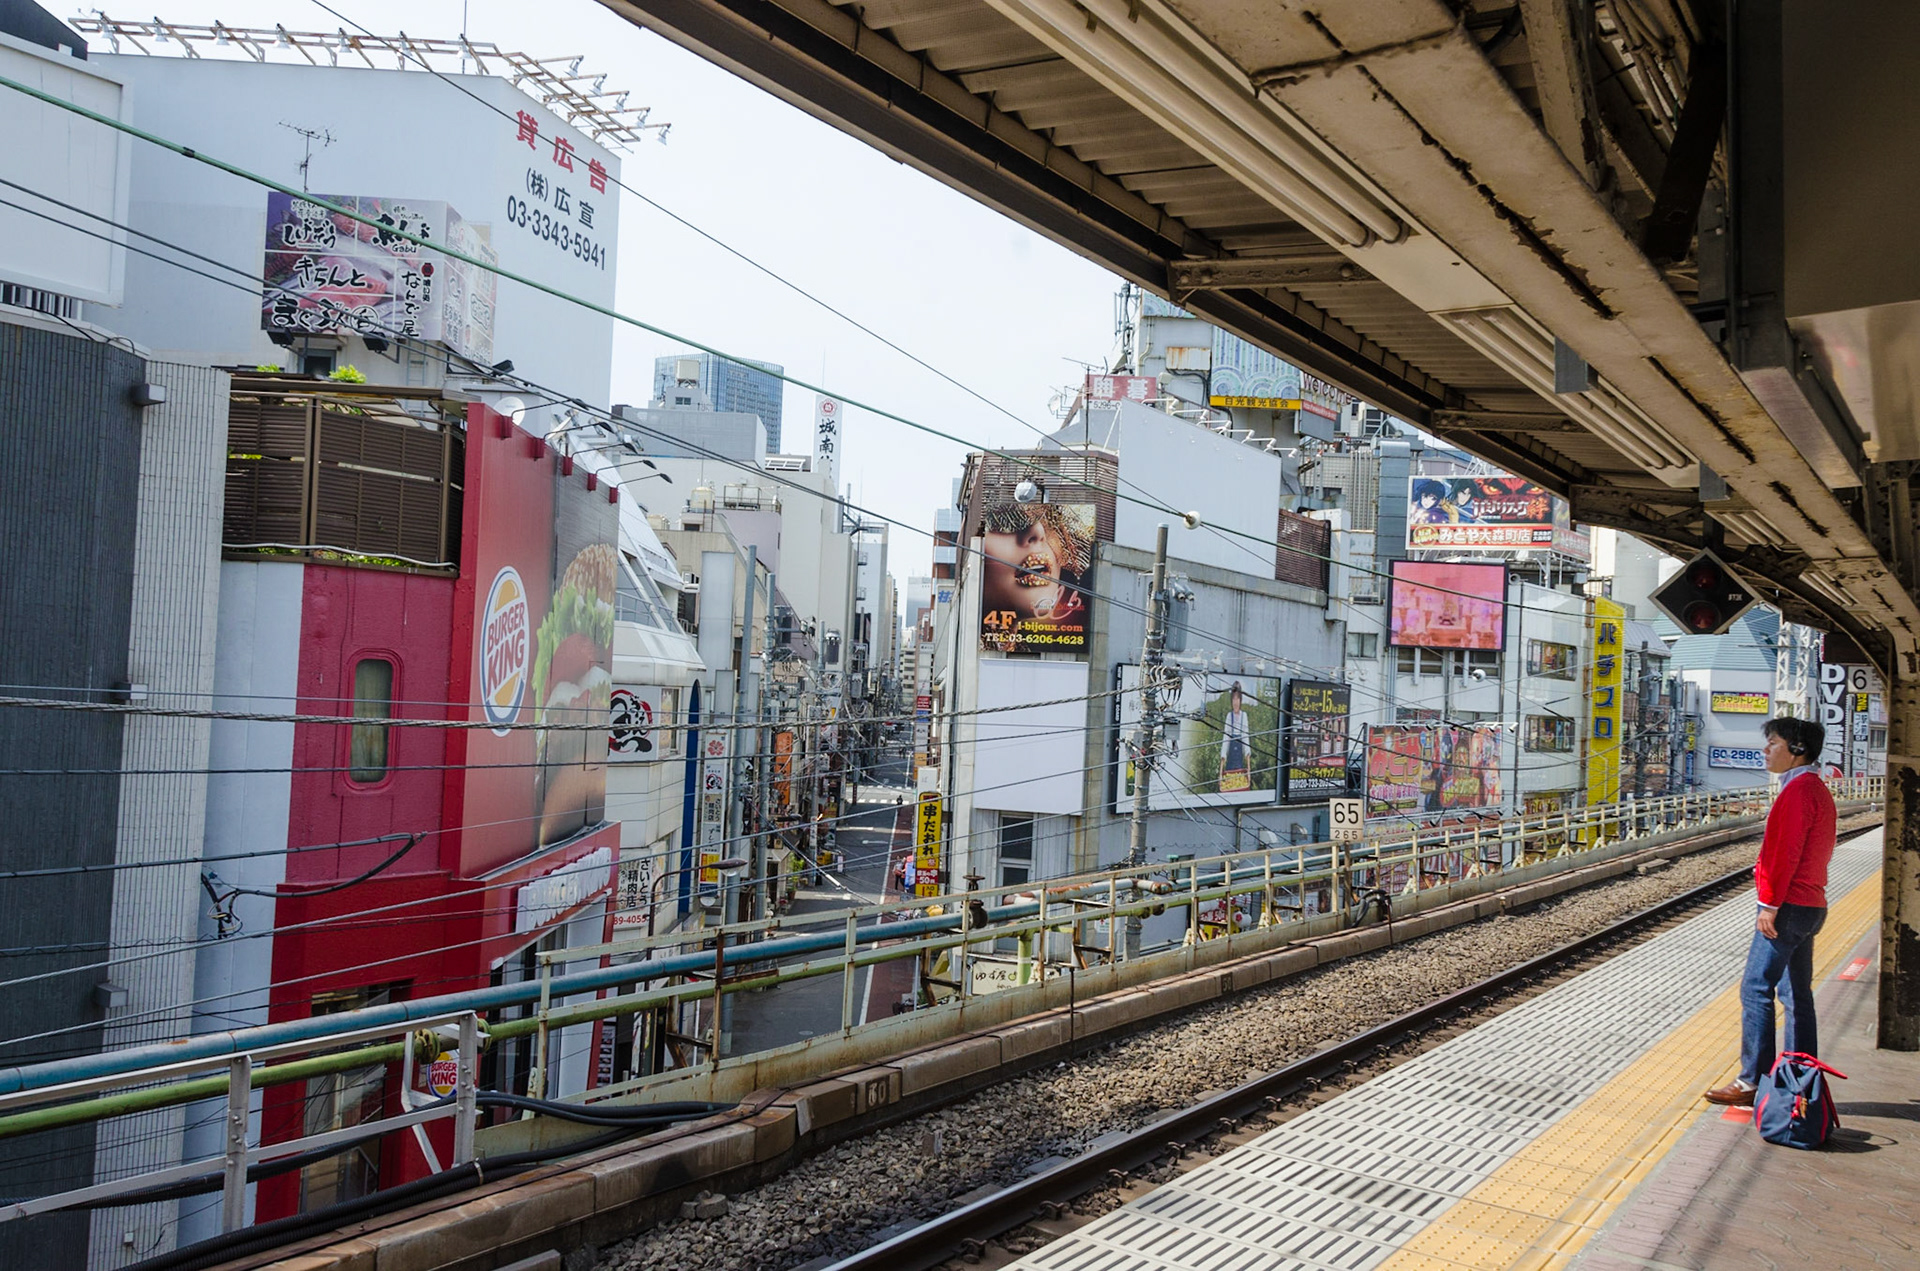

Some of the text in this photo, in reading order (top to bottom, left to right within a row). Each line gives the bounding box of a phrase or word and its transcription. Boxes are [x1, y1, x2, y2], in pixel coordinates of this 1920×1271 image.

[516, 110, 607, 194] 貸広告
[526, 167, 594, 229] (株)広宣
[392, 244, 416, 252] Gabu
[508, 195, 605, 270] 03-3343-5941
[295, 257, 366, 288] きちんと
[819, 418, 837, 463] 城南
[1438, 527, 1532, 545] みとや大森町店
[487, 602, 525, 655] BURGER
[984, 611, 1017, 630] 4F
[984, 633, 1084, 645] TEL:03-6206-4628
[486, 629, 525, 700] KING
[1593, 622, 1617, 738] パチスロ
[1853, 669, 1867, 690] 6
[1820, 664, 1845, 724] DVD
[923, 804, 937, 855] 串だおれ
[1334, 803, 1359, 824] 65
[627, 870, 638, 907] 精肉店
[638, 859, 651, 905] さいとう
[430, 1071, 457, 1086] KING
[431, 1061, 457, 1073] BURGER
